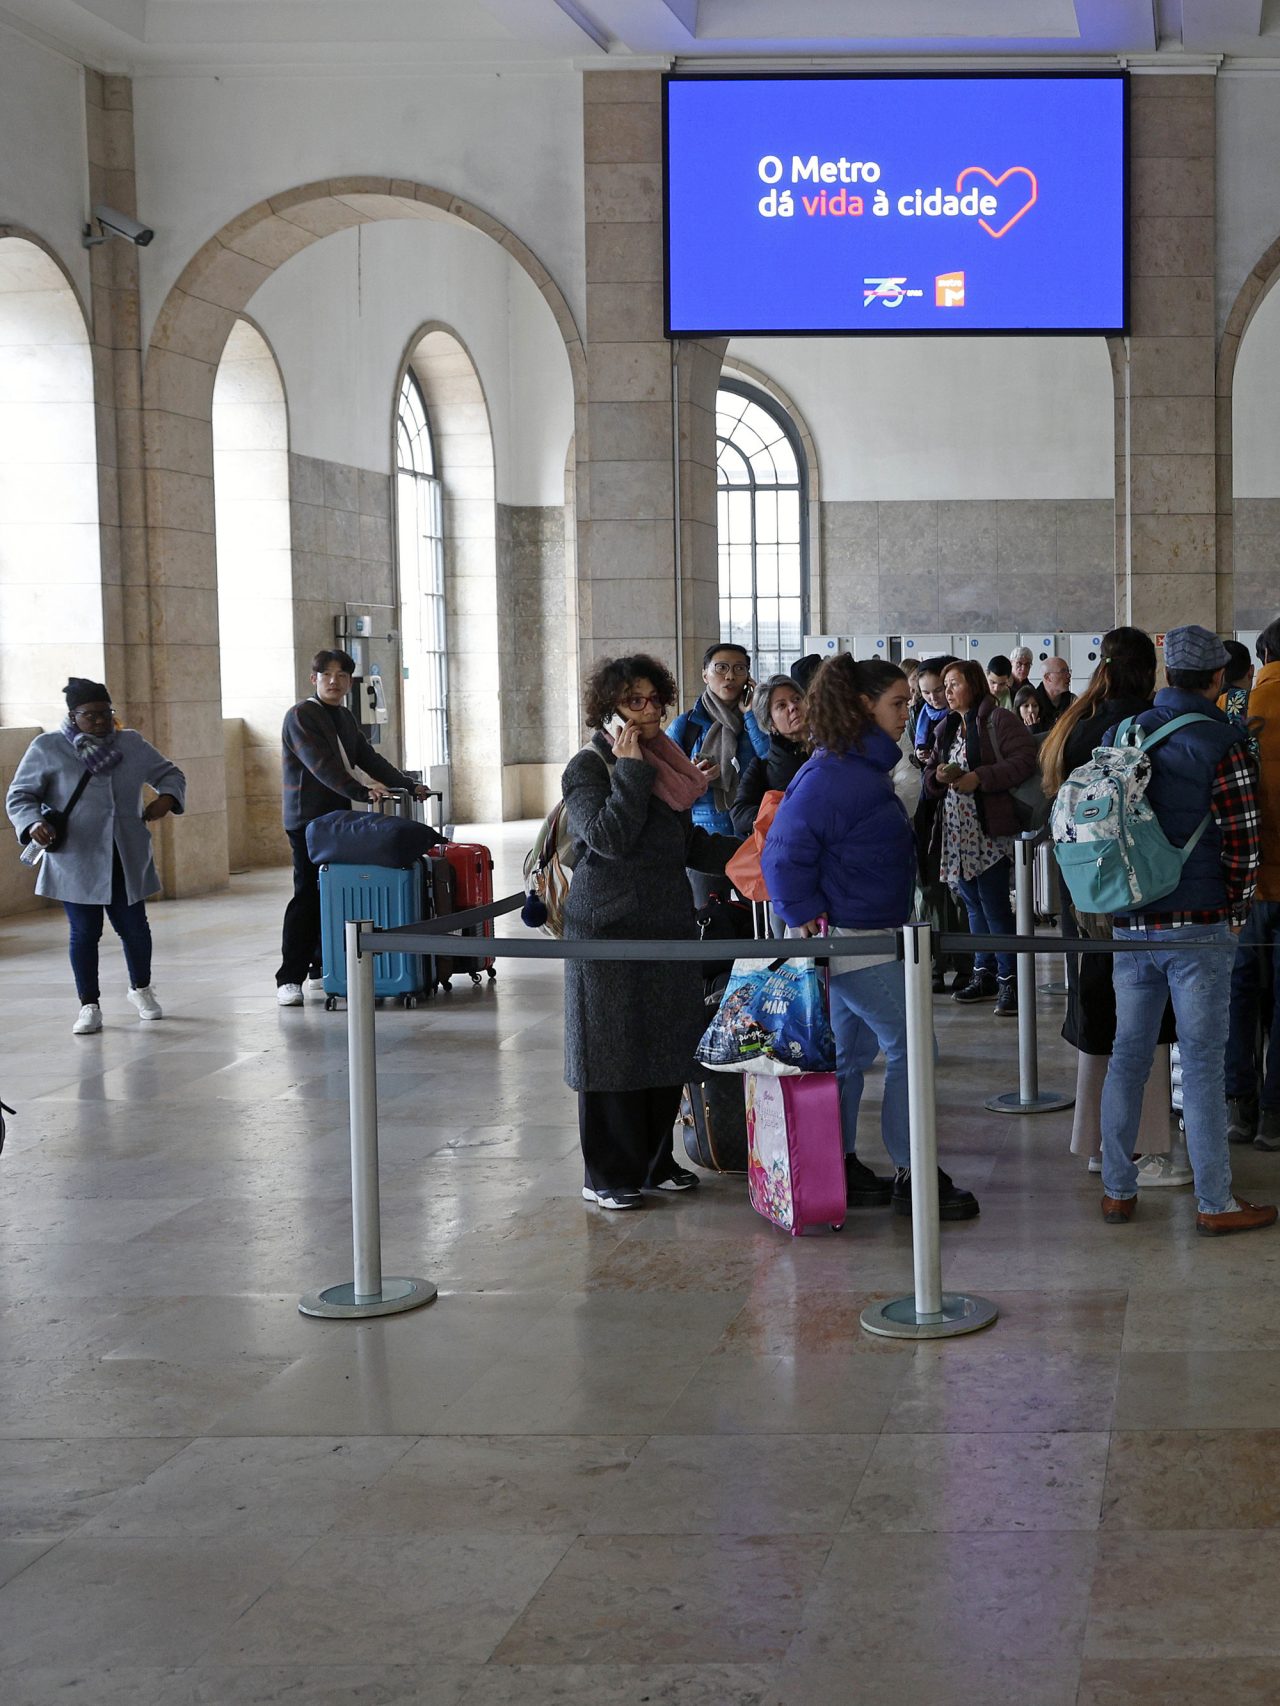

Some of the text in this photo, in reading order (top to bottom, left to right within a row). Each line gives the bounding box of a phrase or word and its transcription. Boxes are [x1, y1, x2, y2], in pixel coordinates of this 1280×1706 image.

[758, 155, 881, 184] O Metro
[758, 187, 998, 217] dá vida à cidade
